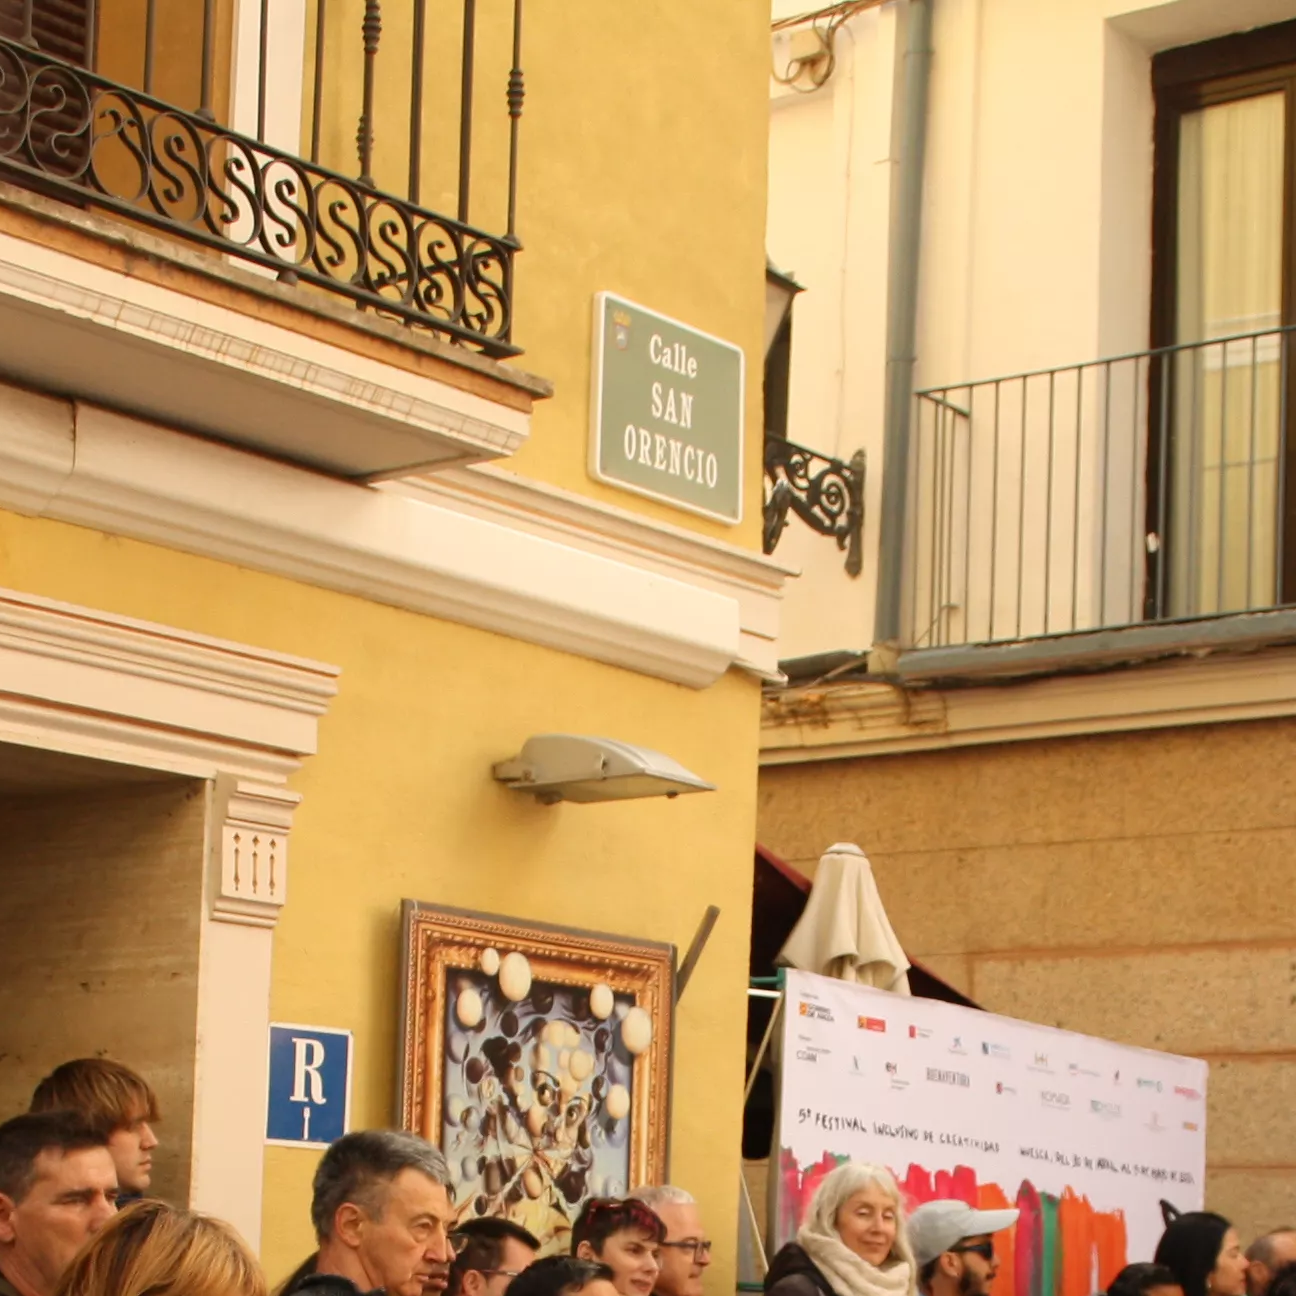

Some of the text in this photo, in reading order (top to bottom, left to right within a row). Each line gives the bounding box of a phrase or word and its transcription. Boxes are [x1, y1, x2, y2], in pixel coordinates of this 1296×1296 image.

[650, 334, 697, 379] Calle
[651, 382, 694, 429] SAN
[624, 424, 718, 488] ORENCIO
[289, 1036, 327, 1105] R
[815, 1112, 868, 1133] FESTIVAL
[873, 1121, 919, 1142] INCLUSIVO
[923, 1130, 934, 1144] DE
